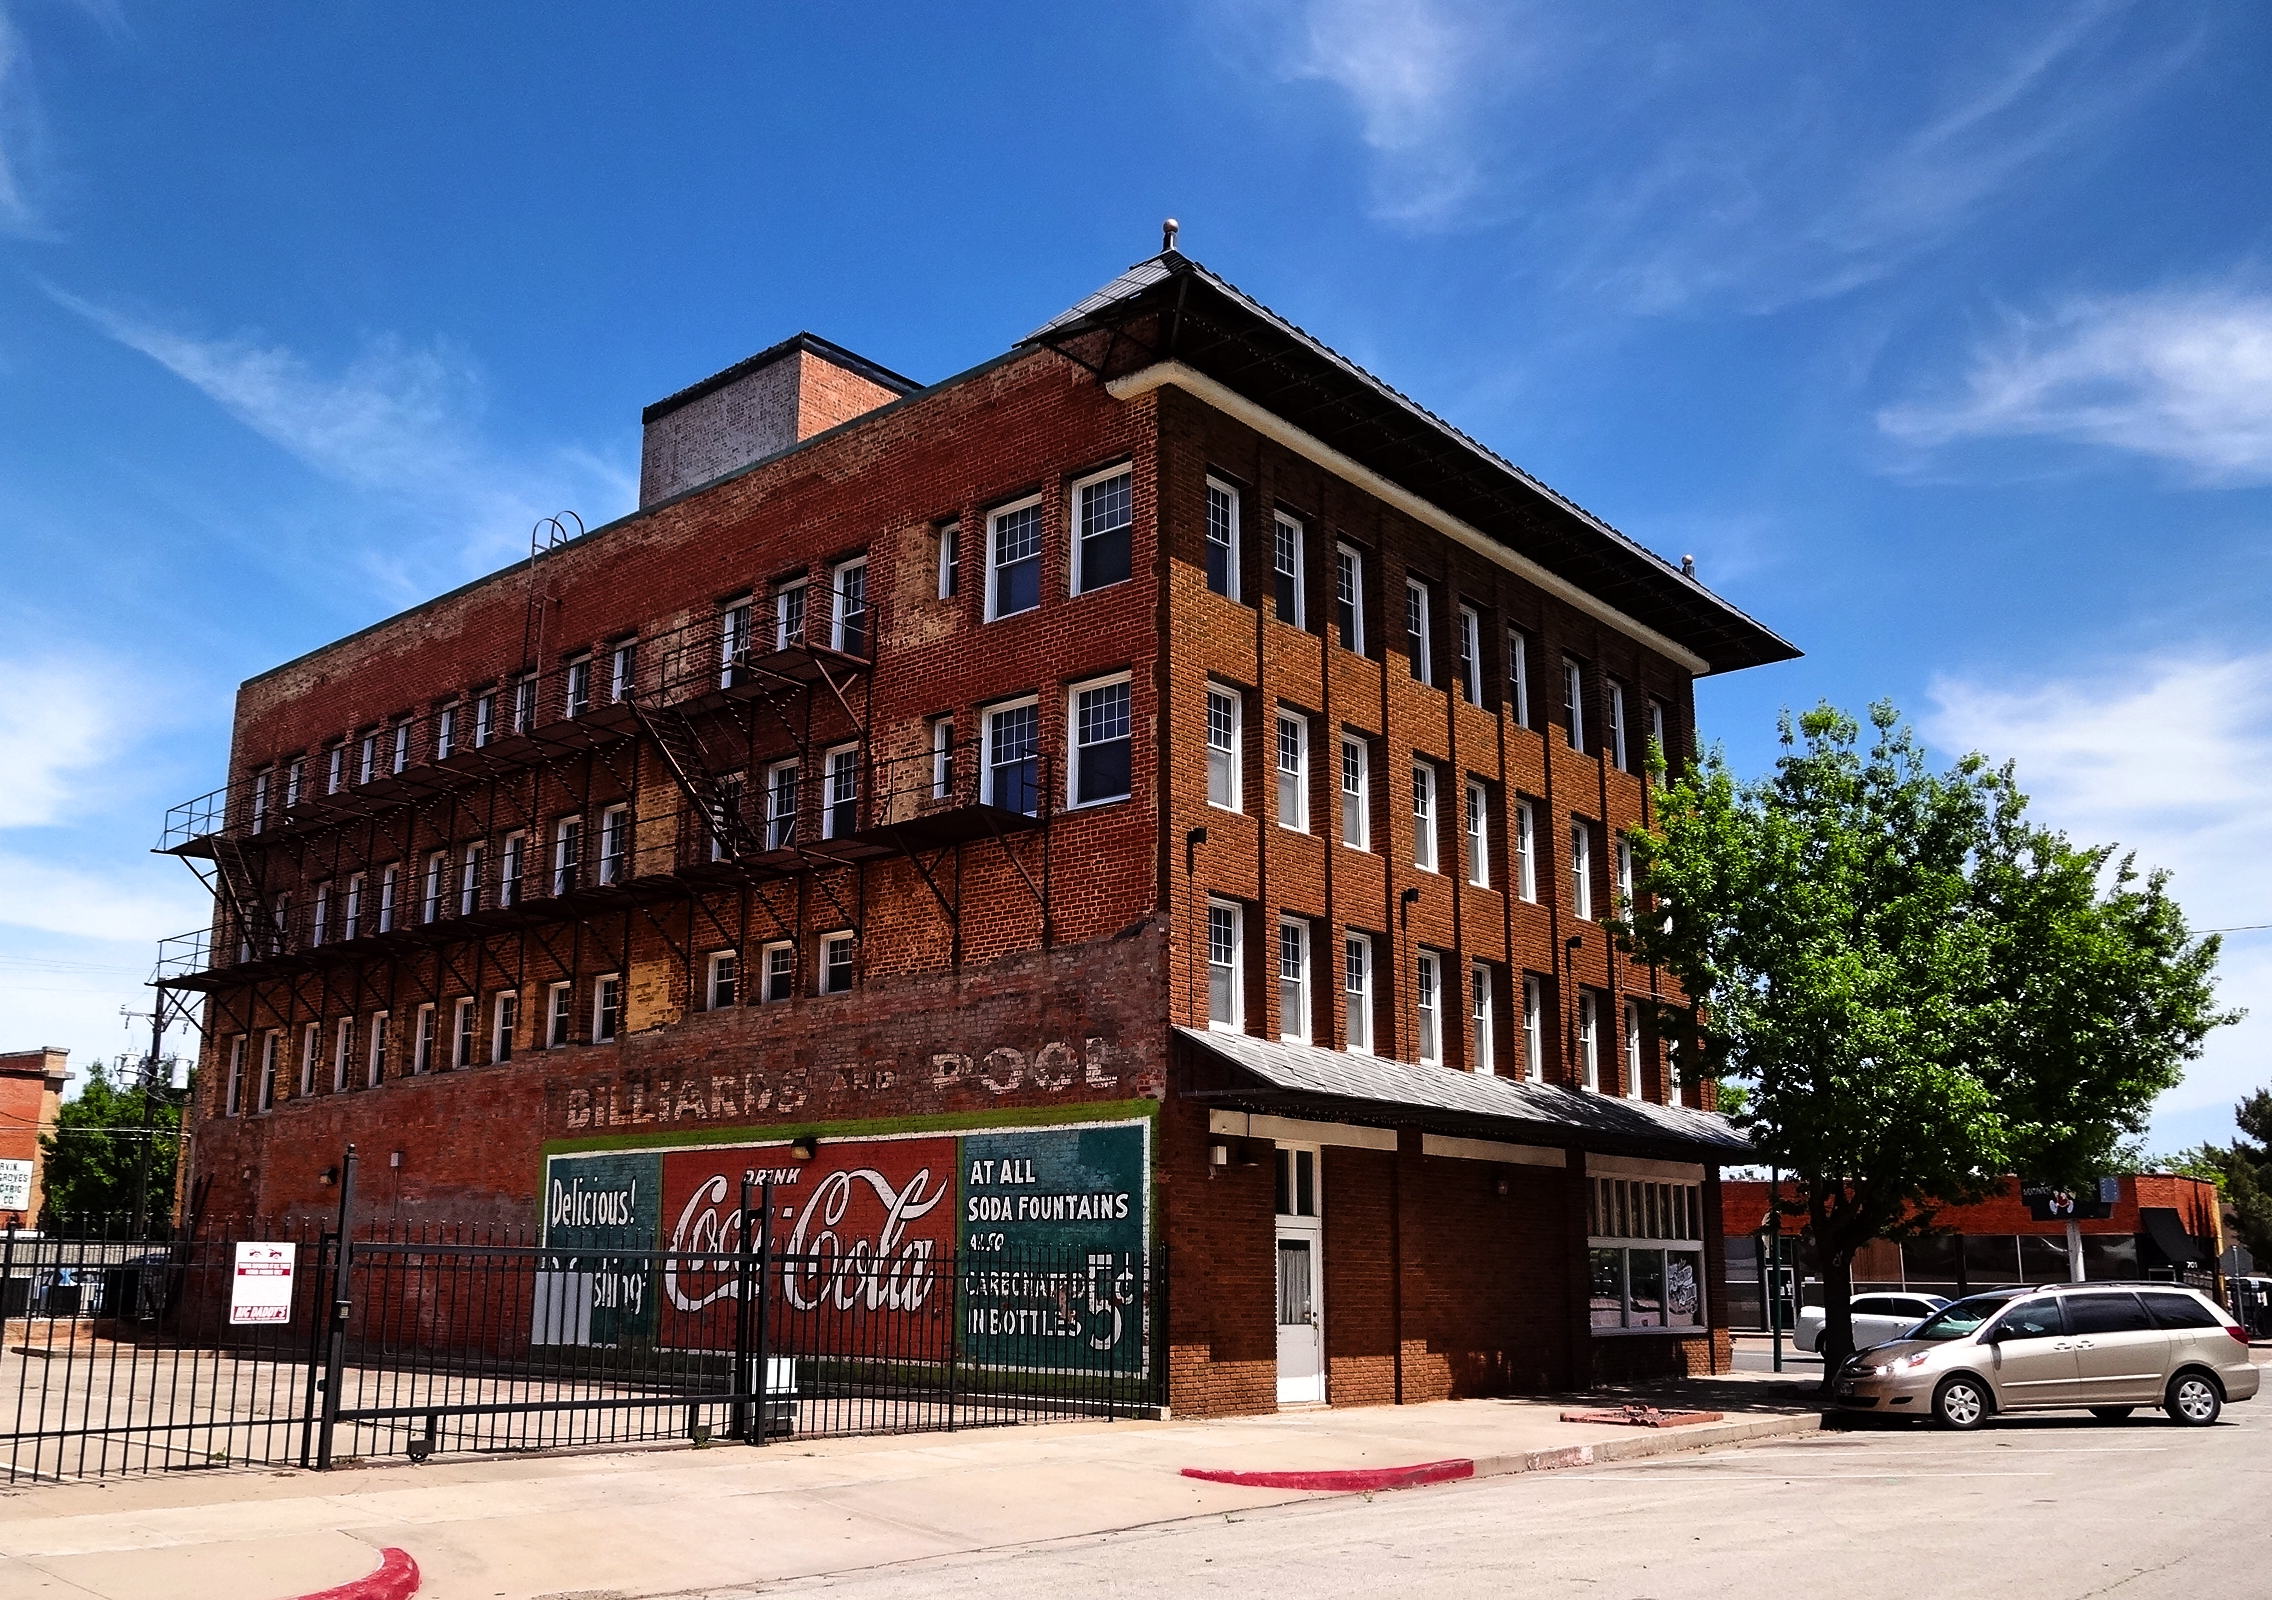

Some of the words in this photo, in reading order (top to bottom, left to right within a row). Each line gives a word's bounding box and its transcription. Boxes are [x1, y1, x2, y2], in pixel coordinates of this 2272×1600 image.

[566, 1067, 808, 1129] BILLIARDS
[932, 1037, 1121, 1095] POOL
[970, 1160, 995, 1185] AT
[999, 1159, 1036, 1184] ALL
[551, 1177, 636, 1227] Delicious!
[968, 1196, 1013, 1222] SODA
[1018, 1193, 1130, 1221] FOUNTAINS
[235, 1306, 251, 1318] BIG
[968, 1308, 984, 1335] IN
[990, 1308, 1082, 1337] BOTTLES
